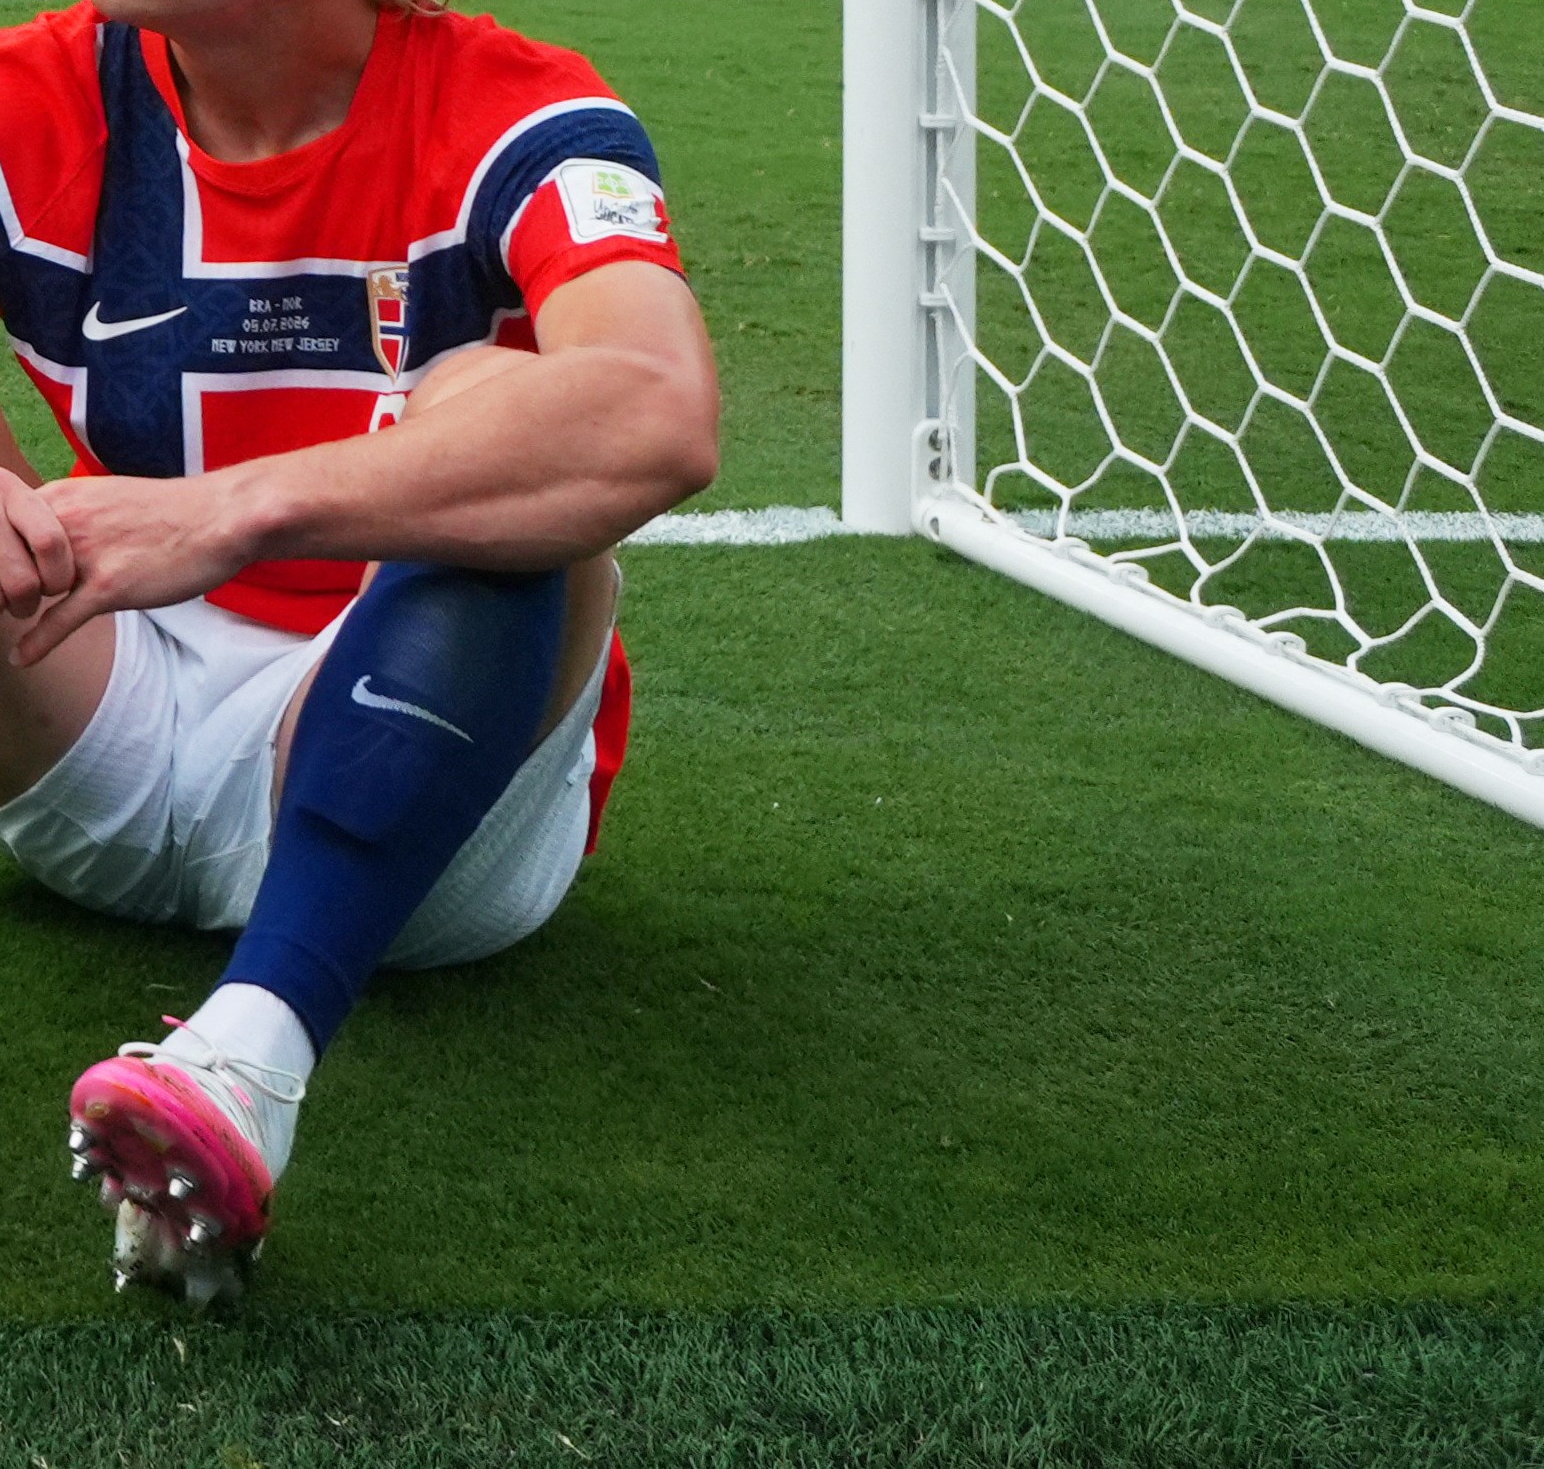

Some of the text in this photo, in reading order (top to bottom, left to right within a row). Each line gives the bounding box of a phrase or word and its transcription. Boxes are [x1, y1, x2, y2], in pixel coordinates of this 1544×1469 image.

[249, 298, 272, 313] BRA
[282, 296, 303, 311] NOR
[212, 337, 340, 353] NEW YORK NEW JERSEY
